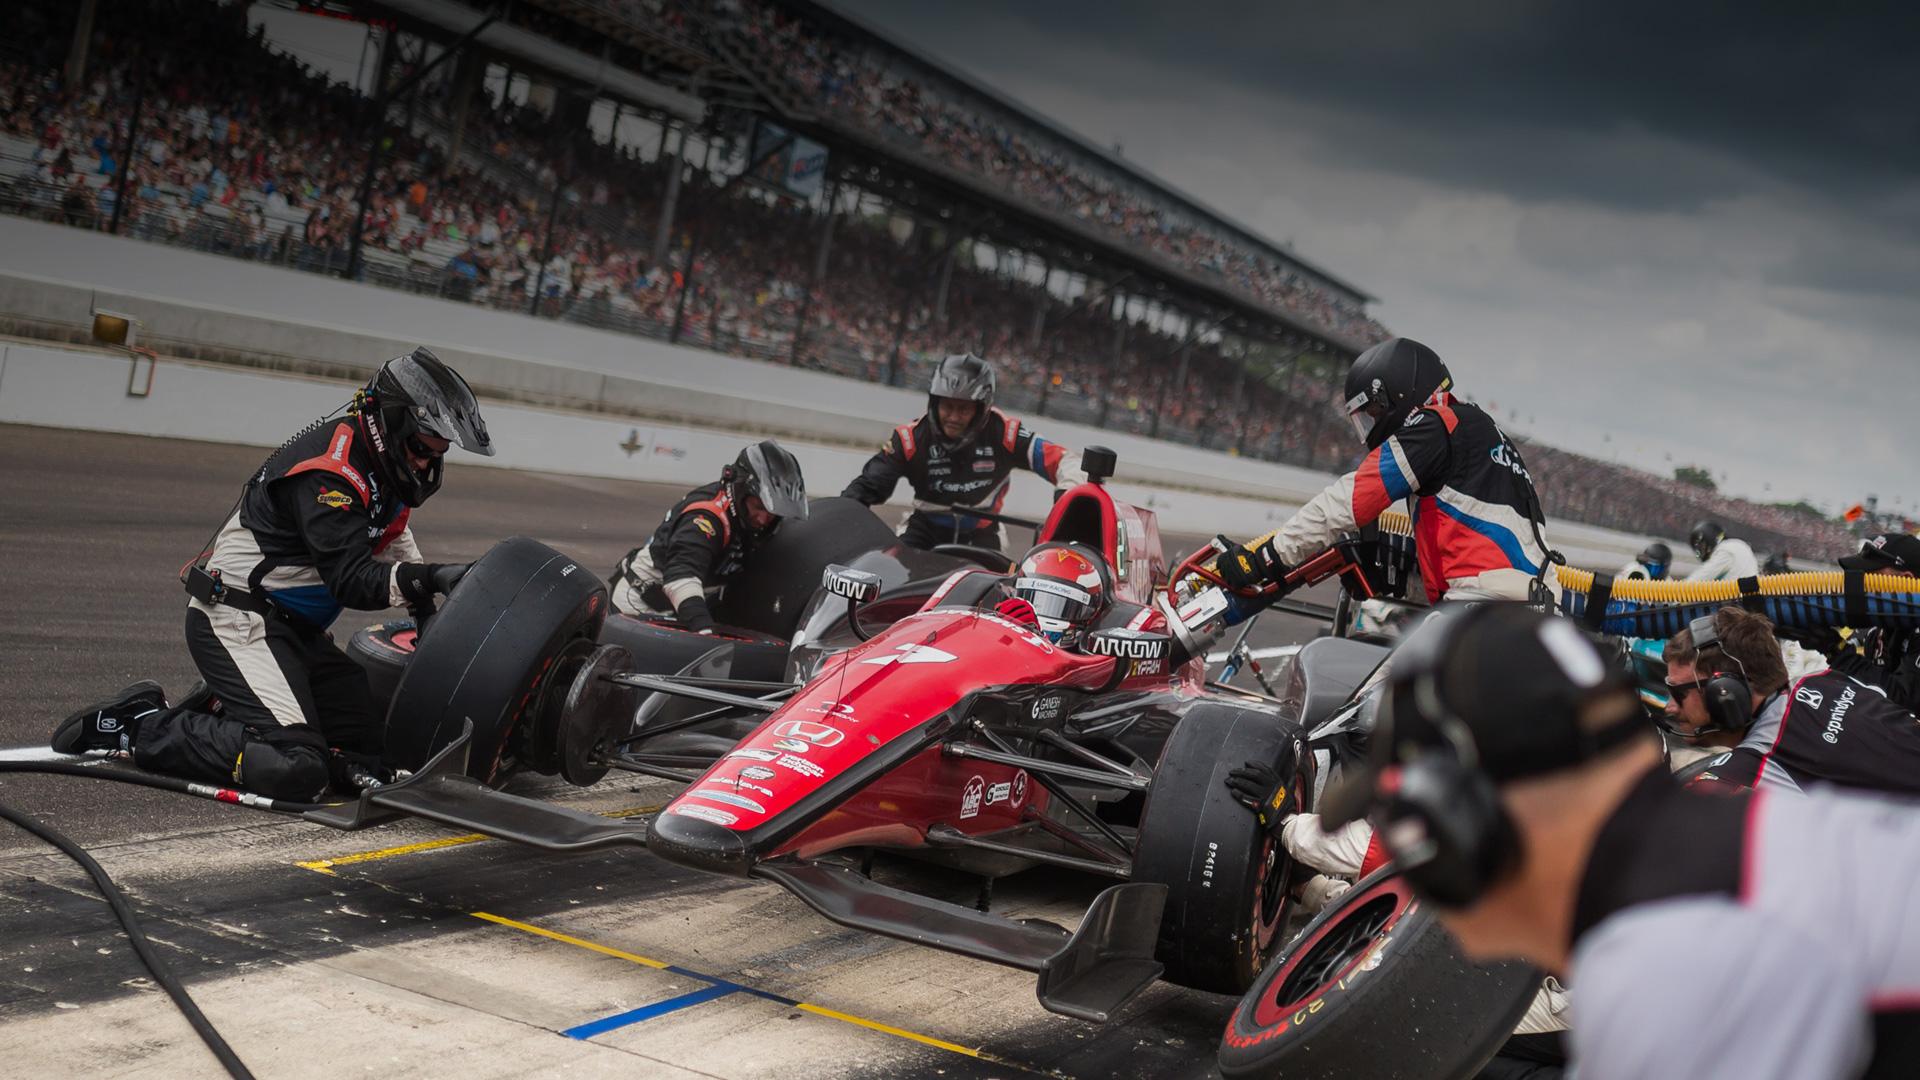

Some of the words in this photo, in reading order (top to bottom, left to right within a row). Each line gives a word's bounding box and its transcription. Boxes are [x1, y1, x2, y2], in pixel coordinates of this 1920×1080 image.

[365, 413, 385, 453] JUSTIN
[822, 568, 867, 600] RROW
[1092, 637, 1162, 659] ARROW
[1040, 696, 1062, 711] GANESH
